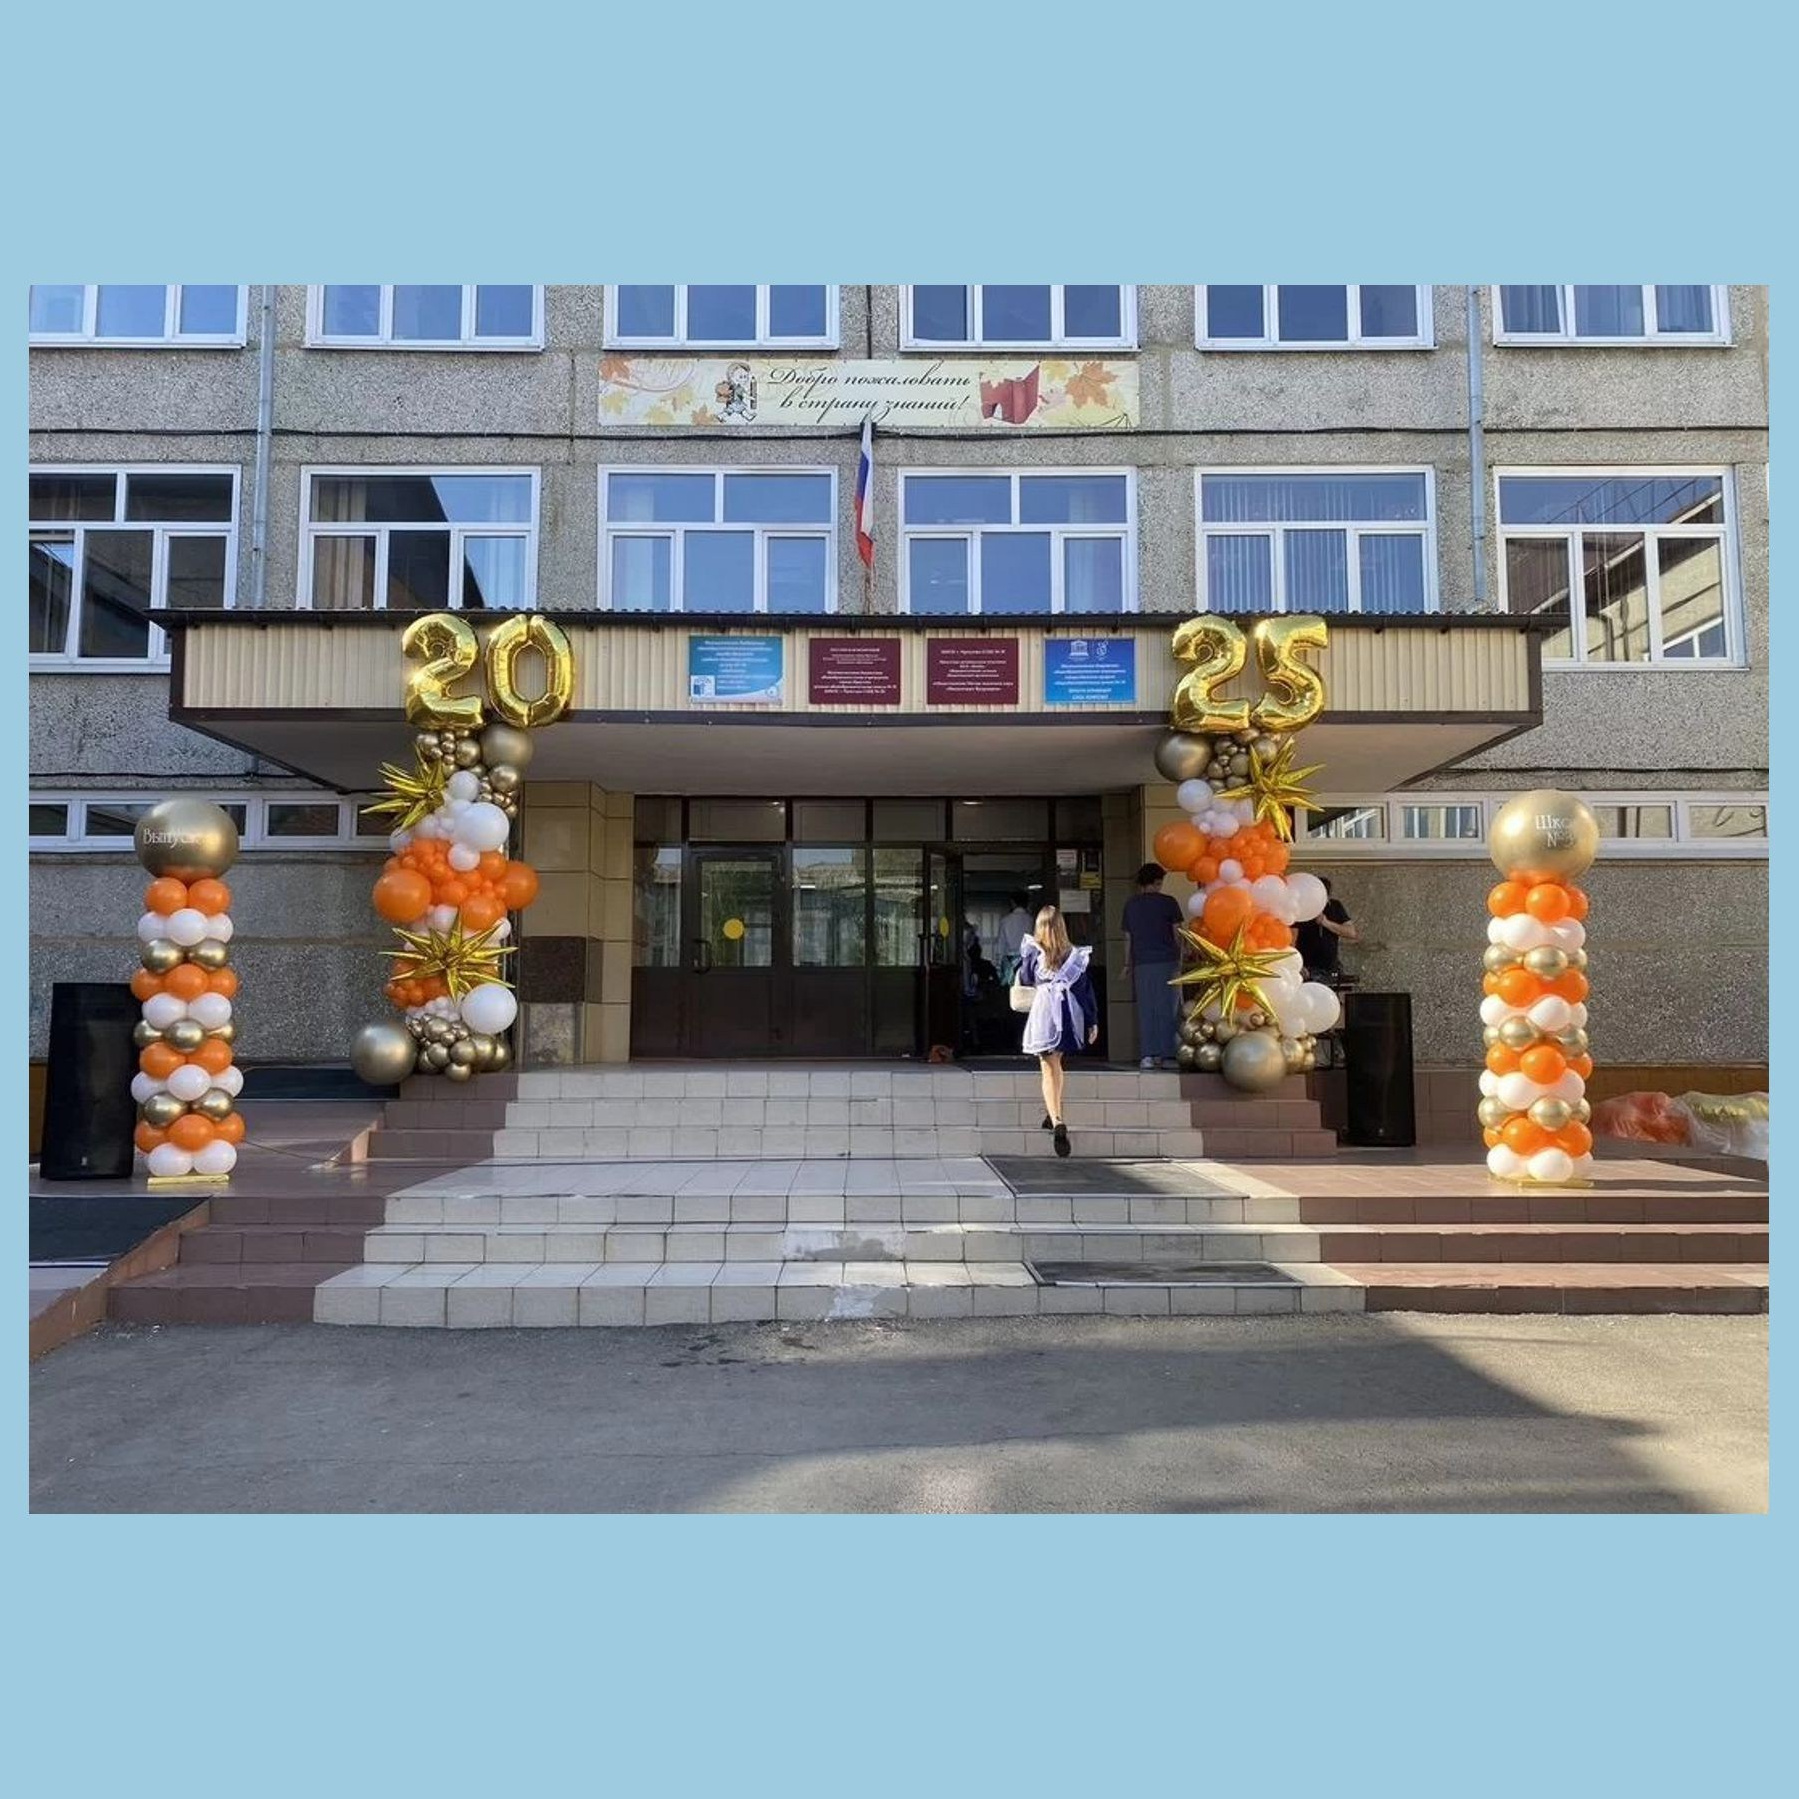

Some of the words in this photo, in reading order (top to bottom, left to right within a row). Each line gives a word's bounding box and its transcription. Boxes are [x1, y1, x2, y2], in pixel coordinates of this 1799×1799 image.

[768, 366, 838, 399] Добро
[844, 359, 970, 386] пожаловать
[780, 385, 803, 408] в
[798, 396, 877, 424] страну
[871, 395, 970, 423] знаний!
[402, 613, 576, 730] 20
[1172, 614, 1328, 734] 25
